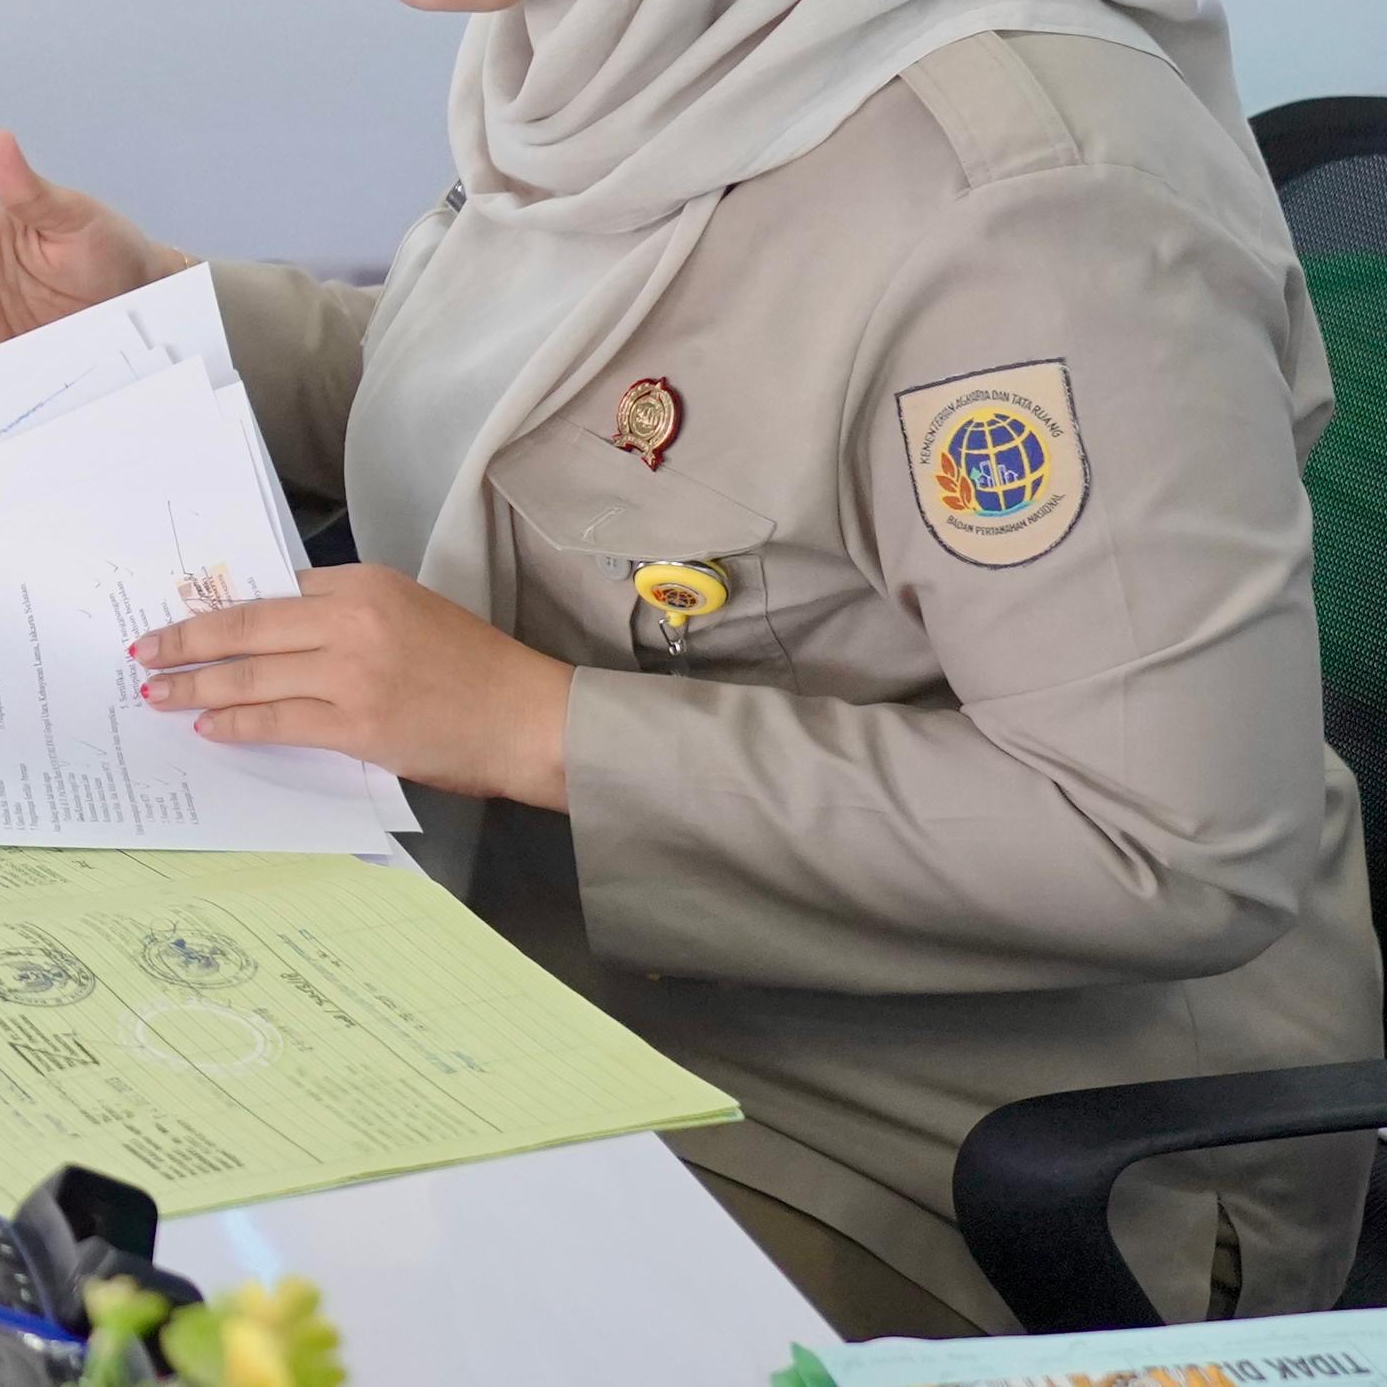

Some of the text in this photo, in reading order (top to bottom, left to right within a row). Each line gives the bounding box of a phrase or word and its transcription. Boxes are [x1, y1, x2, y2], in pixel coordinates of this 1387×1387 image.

[919, 390, 1063, 464] KEMENTERIAN AGRARIA DAN TATA RUANG
[946, 493, 1066, 535] BADAN PERTANAHAN NASIONAL
[110, 592, 129, 644] Tanggungan
[1263, 1352, 1371, 1380] TIDAK
